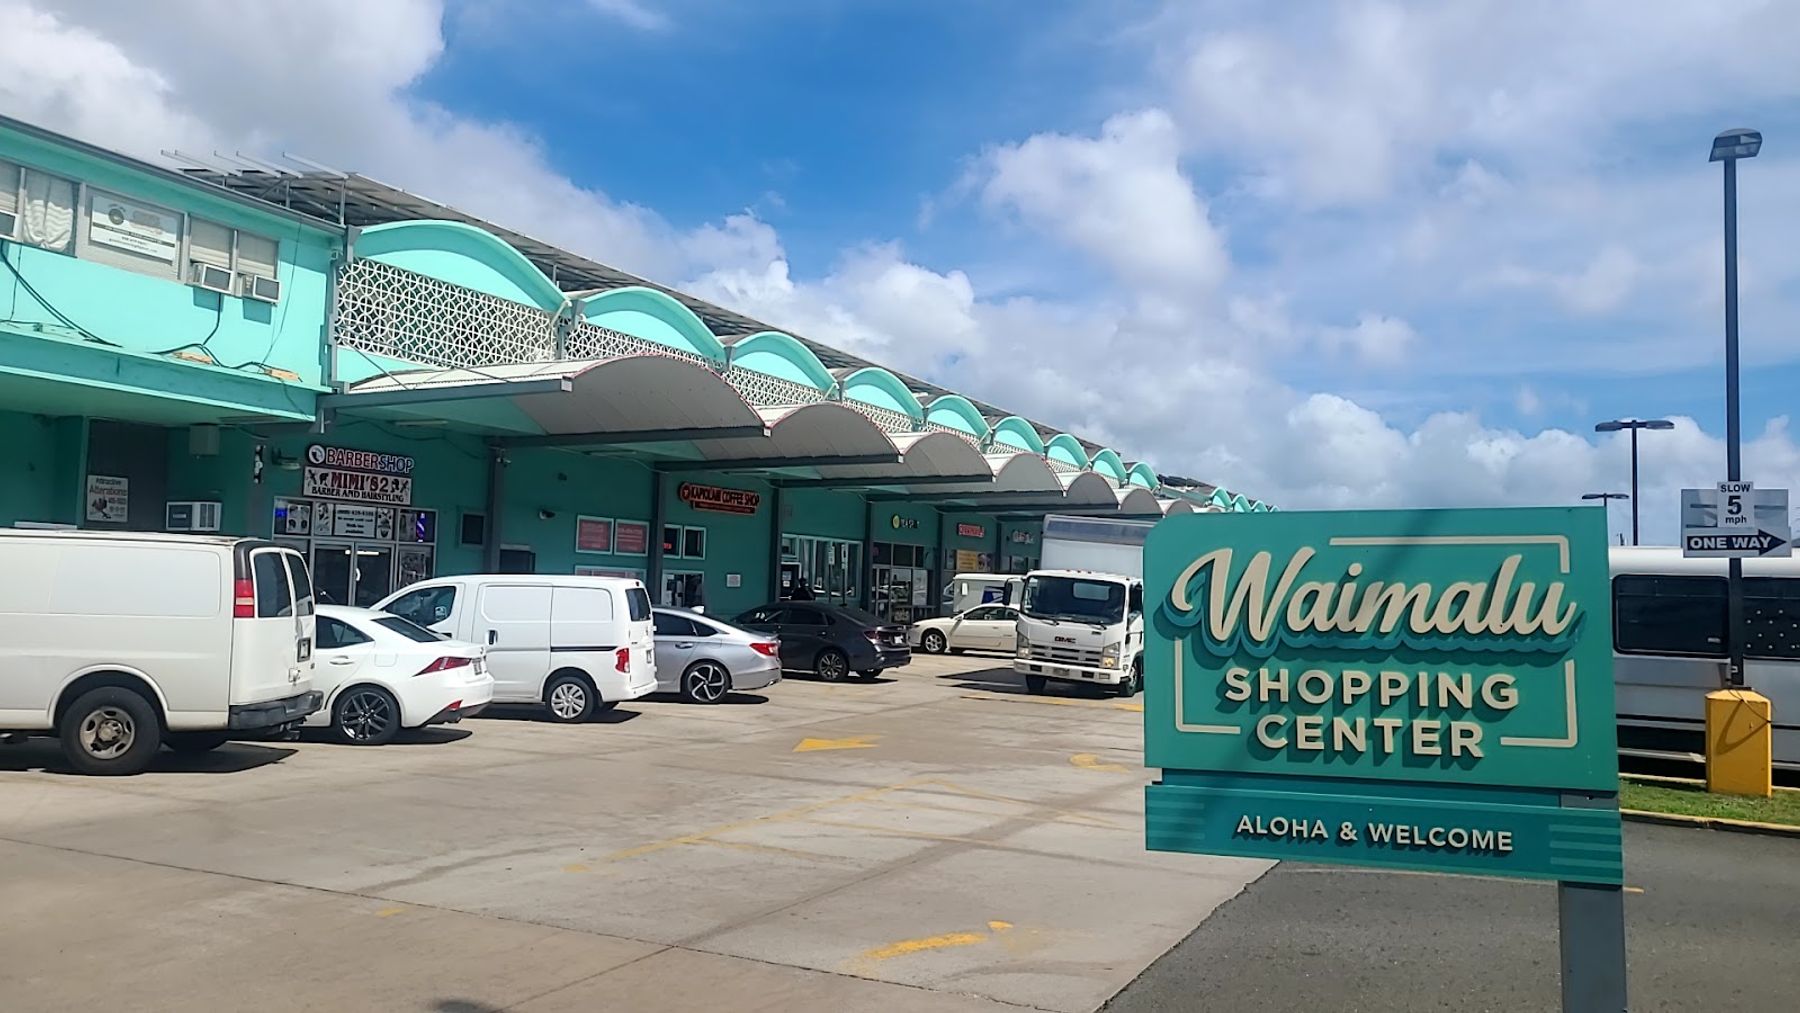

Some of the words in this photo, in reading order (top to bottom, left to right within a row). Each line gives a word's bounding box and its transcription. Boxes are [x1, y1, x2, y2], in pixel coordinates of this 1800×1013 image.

[326, 447, 414, 473] BARBERSHOP
[311, 486, 340, 497] BARBER
[342, 489, 360, 499] AND
[1720, 484, 1751, 493] SLOW
[722, 491, 744, 505] COFFEE
[744, 493, 760, 507] SHOP
[1727, 495, 1742, 515] 5
[1725, 515, 1747, 525] mph
[1689, 537, 1728, 549] ONE
[1732, 536, 1772, 549] WAY
[1171, 546, 1577, 642] Waimalu
[1054, 636, 1076, 644] GMC
[1225, 667, 1520, 710] SHOPPING
[1256, 714, 1485, 758] CENTER
[1236, 814, 1329, 839] ALOHA
[1339, 821, 1358, 841] &
[1368, 823, 1513, 852] WELCOME
